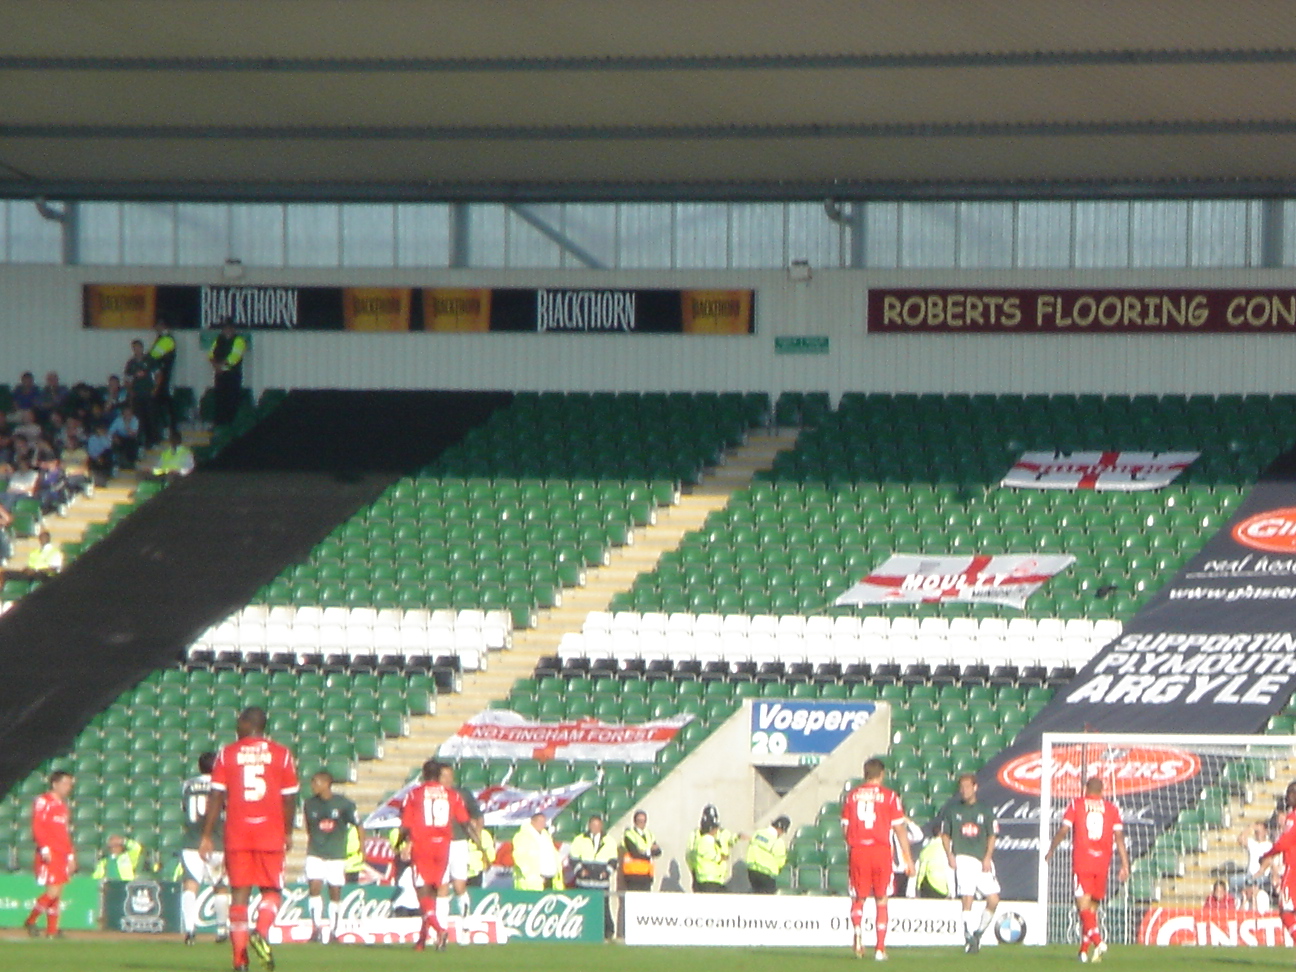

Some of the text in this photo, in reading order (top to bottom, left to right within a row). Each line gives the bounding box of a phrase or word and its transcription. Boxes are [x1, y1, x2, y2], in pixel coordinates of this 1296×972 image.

[537, 289, 636, 332] BLACKTHORN
[883, 295, 1021, 326] ROBERTS
[1037, 295, 1209, 326] FLOORING
[1066, 673, 1290, 705] ARGYLE
[473, 726, 656, 743] NOTTINGHAM FOREST
[759, 703, 870, 735] Vospers
[752, 731, 788, 755] 20
[243, 765, 267, 801] 5
[857, 801, 876, 829] 4
[637, 914, 957, 934] www.oceanbmw.com 015 202828
